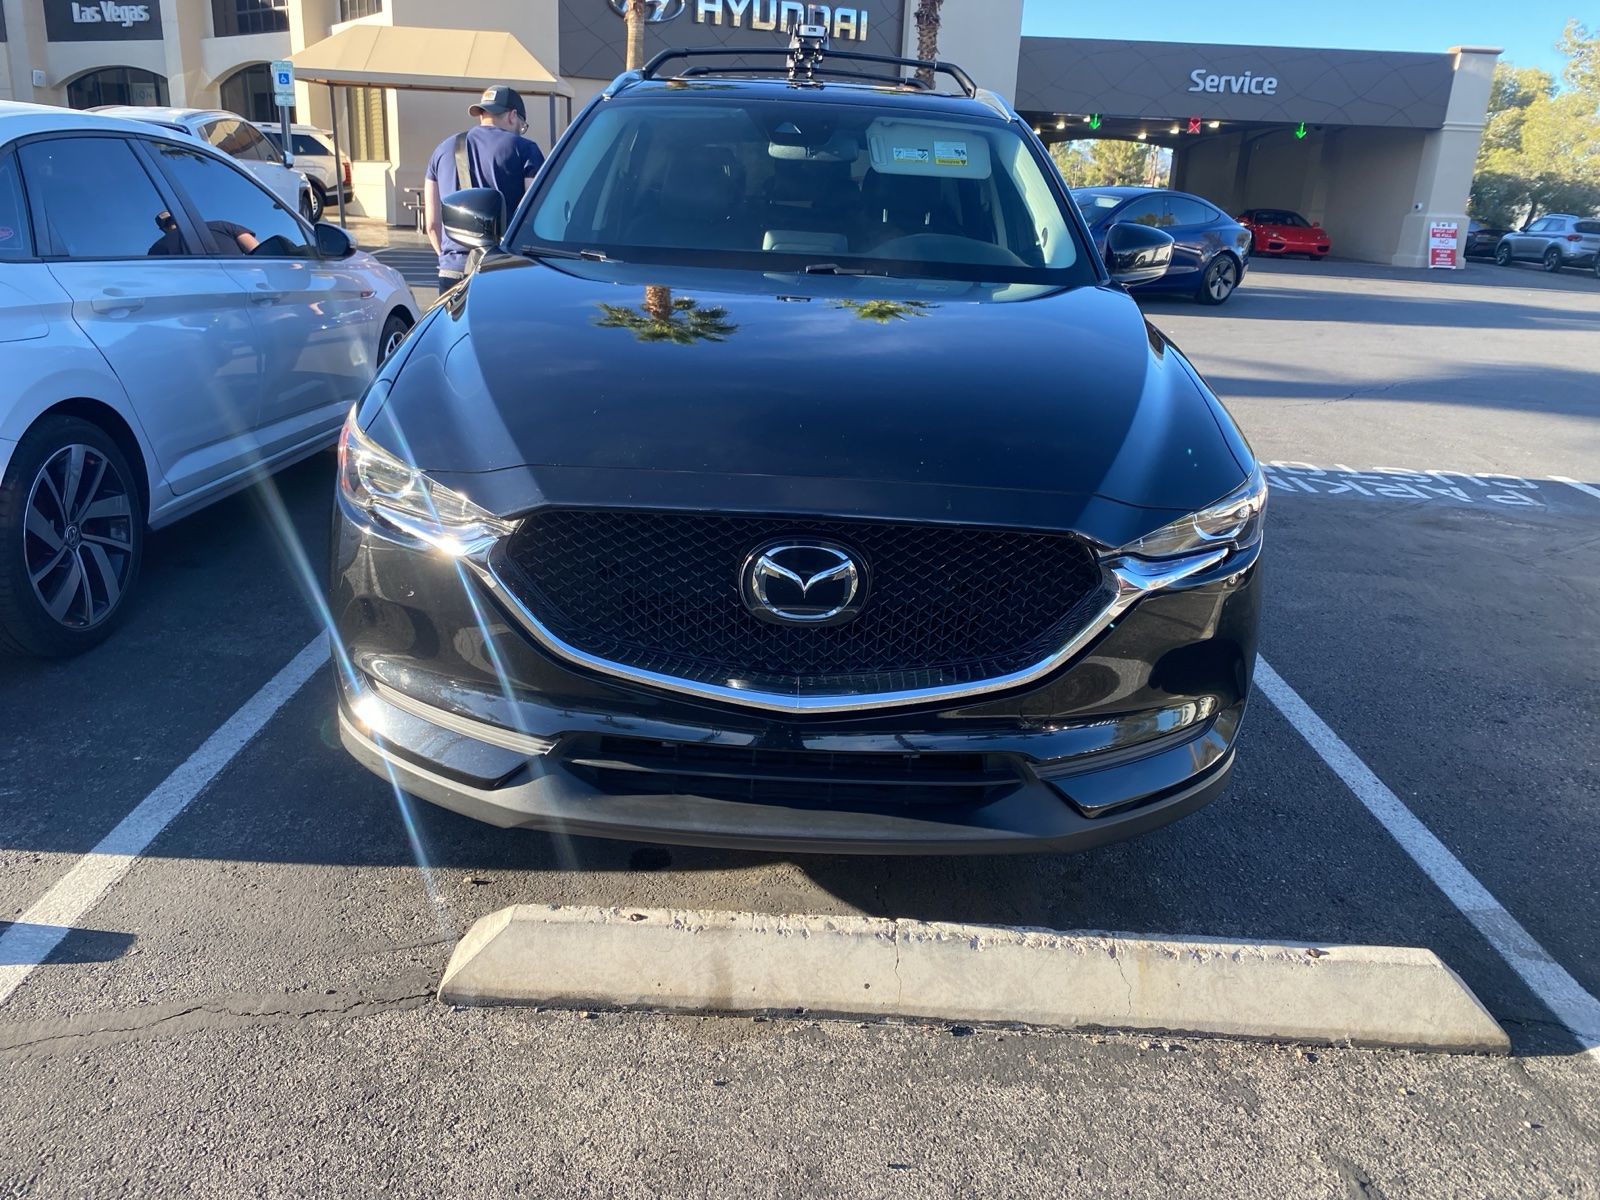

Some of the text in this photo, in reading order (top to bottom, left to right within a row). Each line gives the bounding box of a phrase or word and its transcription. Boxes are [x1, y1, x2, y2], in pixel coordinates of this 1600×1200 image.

[71, 0, 150, 27] Las Vegas
[696, 0, 868, 41] HYUNDAI
[1188, 68, 1278, 95] Service
[1259, 460, 1539, 489] CUSTO
